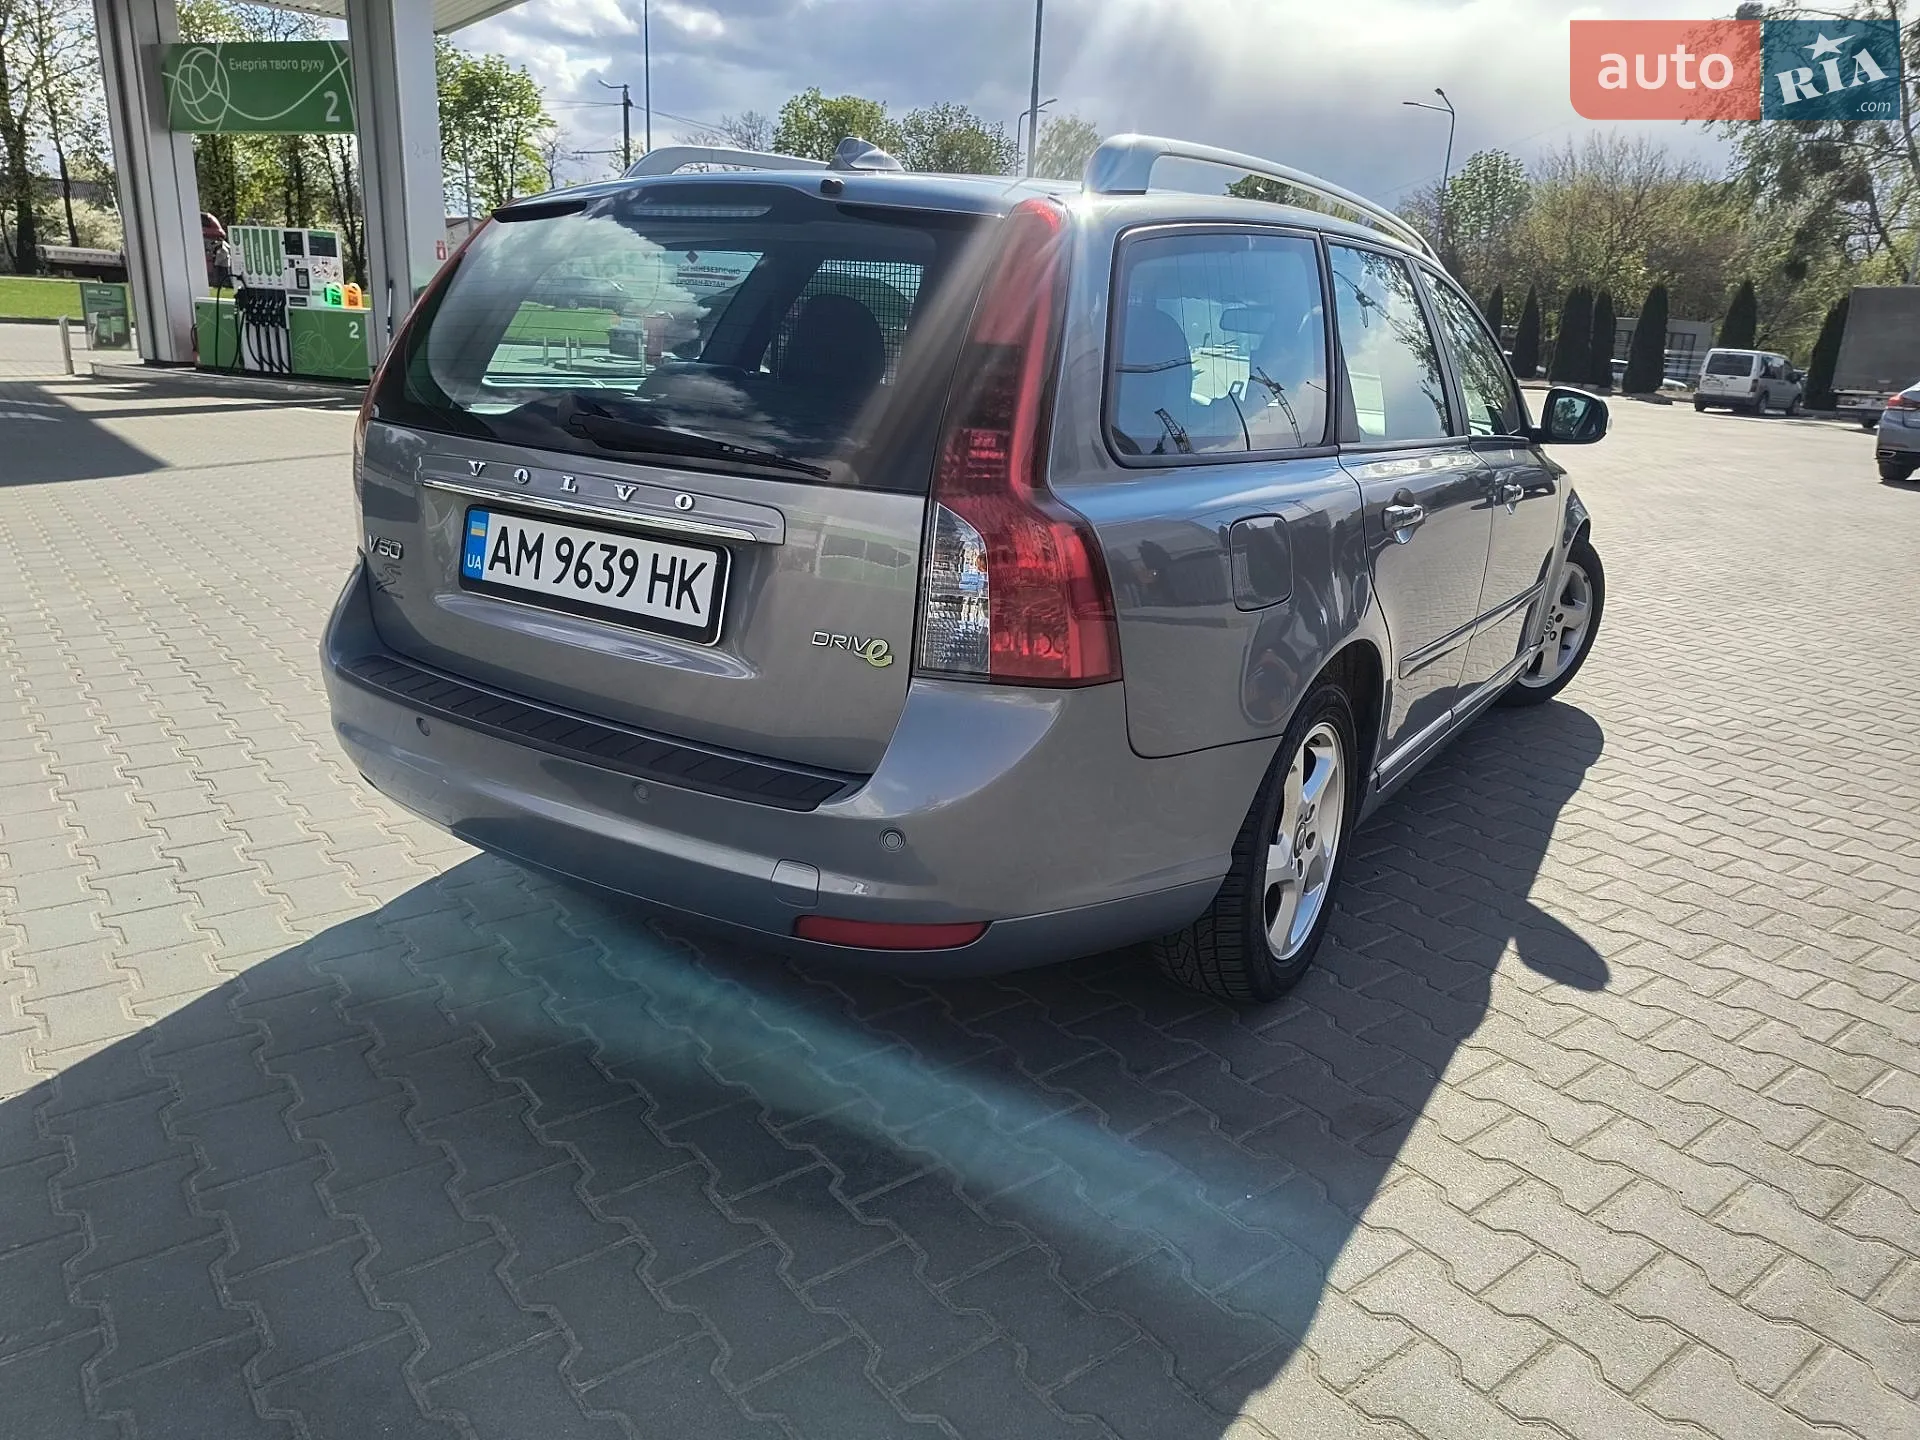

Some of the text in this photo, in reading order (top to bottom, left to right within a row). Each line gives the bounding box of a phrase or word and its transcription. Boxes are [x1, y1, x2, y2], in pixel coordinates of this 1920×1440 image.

[229, 57, 324, 72] Енергія твого руху
[323, 90, 340, 122] 2
[349, 320, 360, 339] 2
[468, 460, 694, 511] VOLVO
[467, 554, 482, 571] UA
[488, 526, 707, 614] AM 9639 HK
